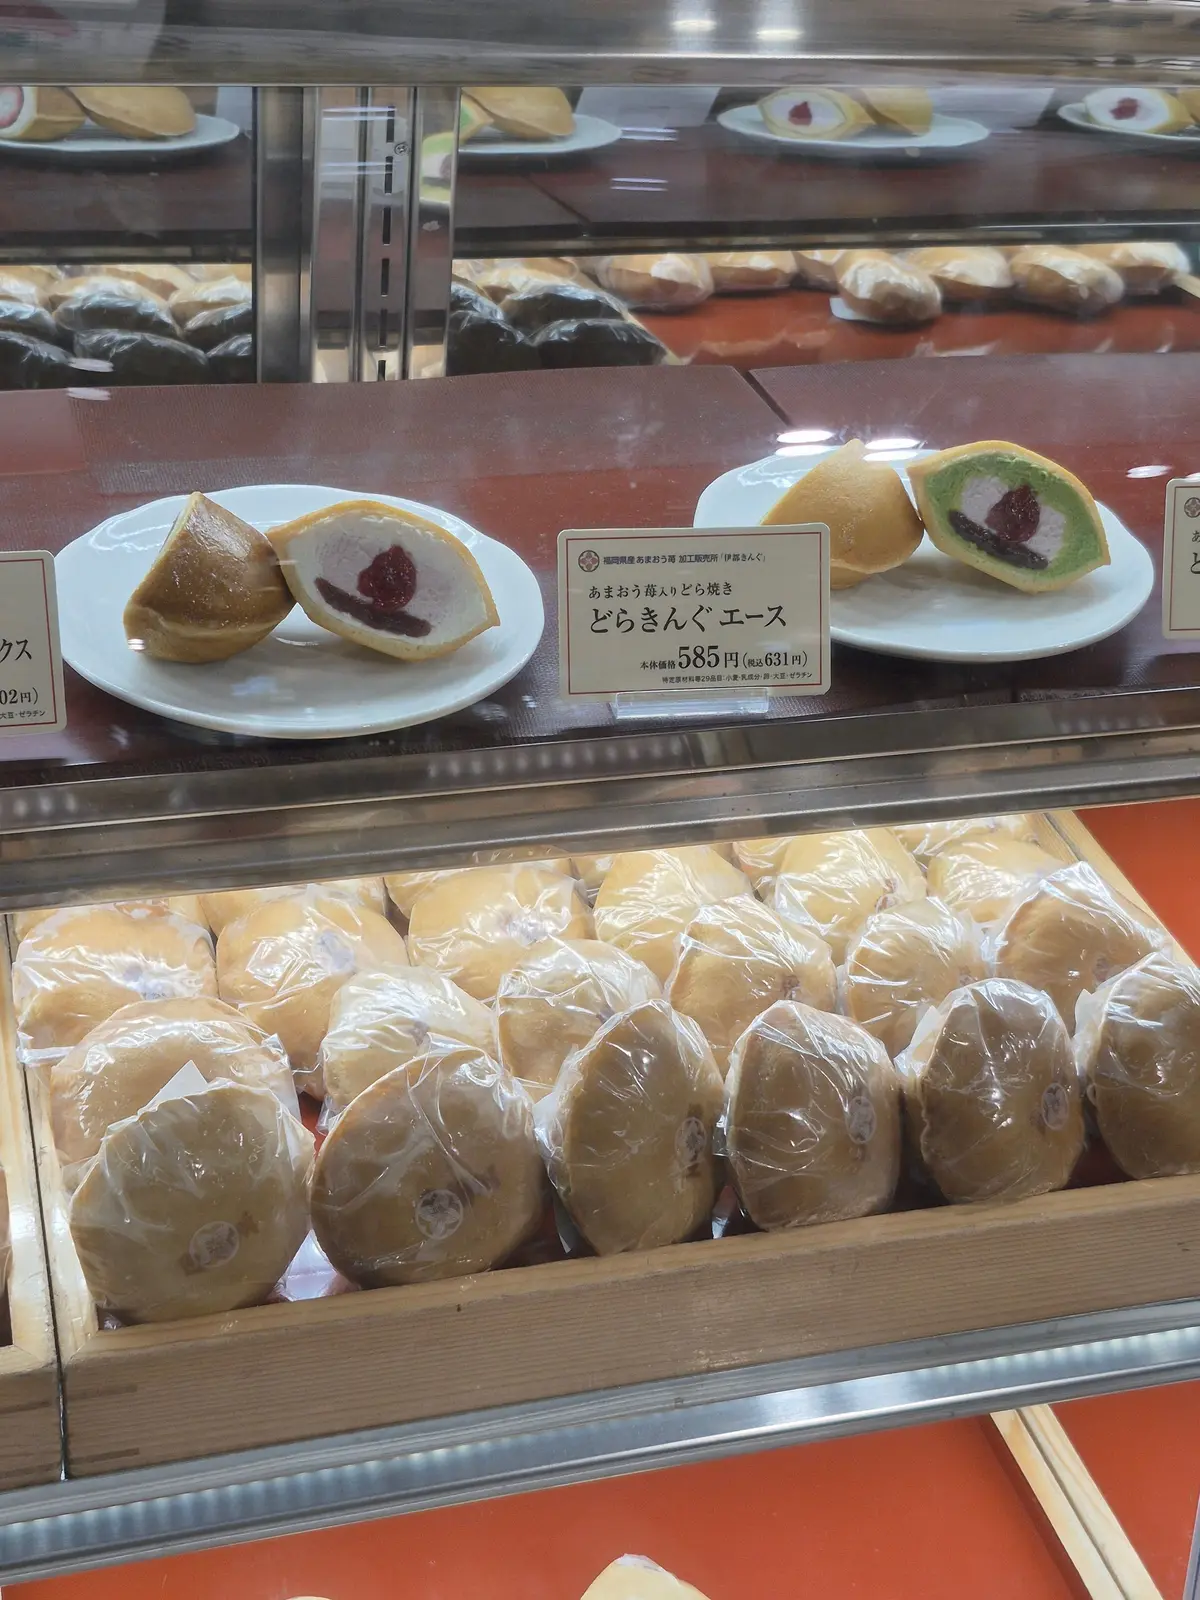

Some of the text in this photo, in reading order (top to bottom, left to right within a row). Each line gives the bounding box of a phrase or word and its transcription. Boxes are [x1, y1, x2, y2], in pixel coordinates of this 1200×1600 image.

[588, 580, 734, 600] あまおう苺入りどら焼き
[589, 604, 788, 633] どらきんぐ エース
